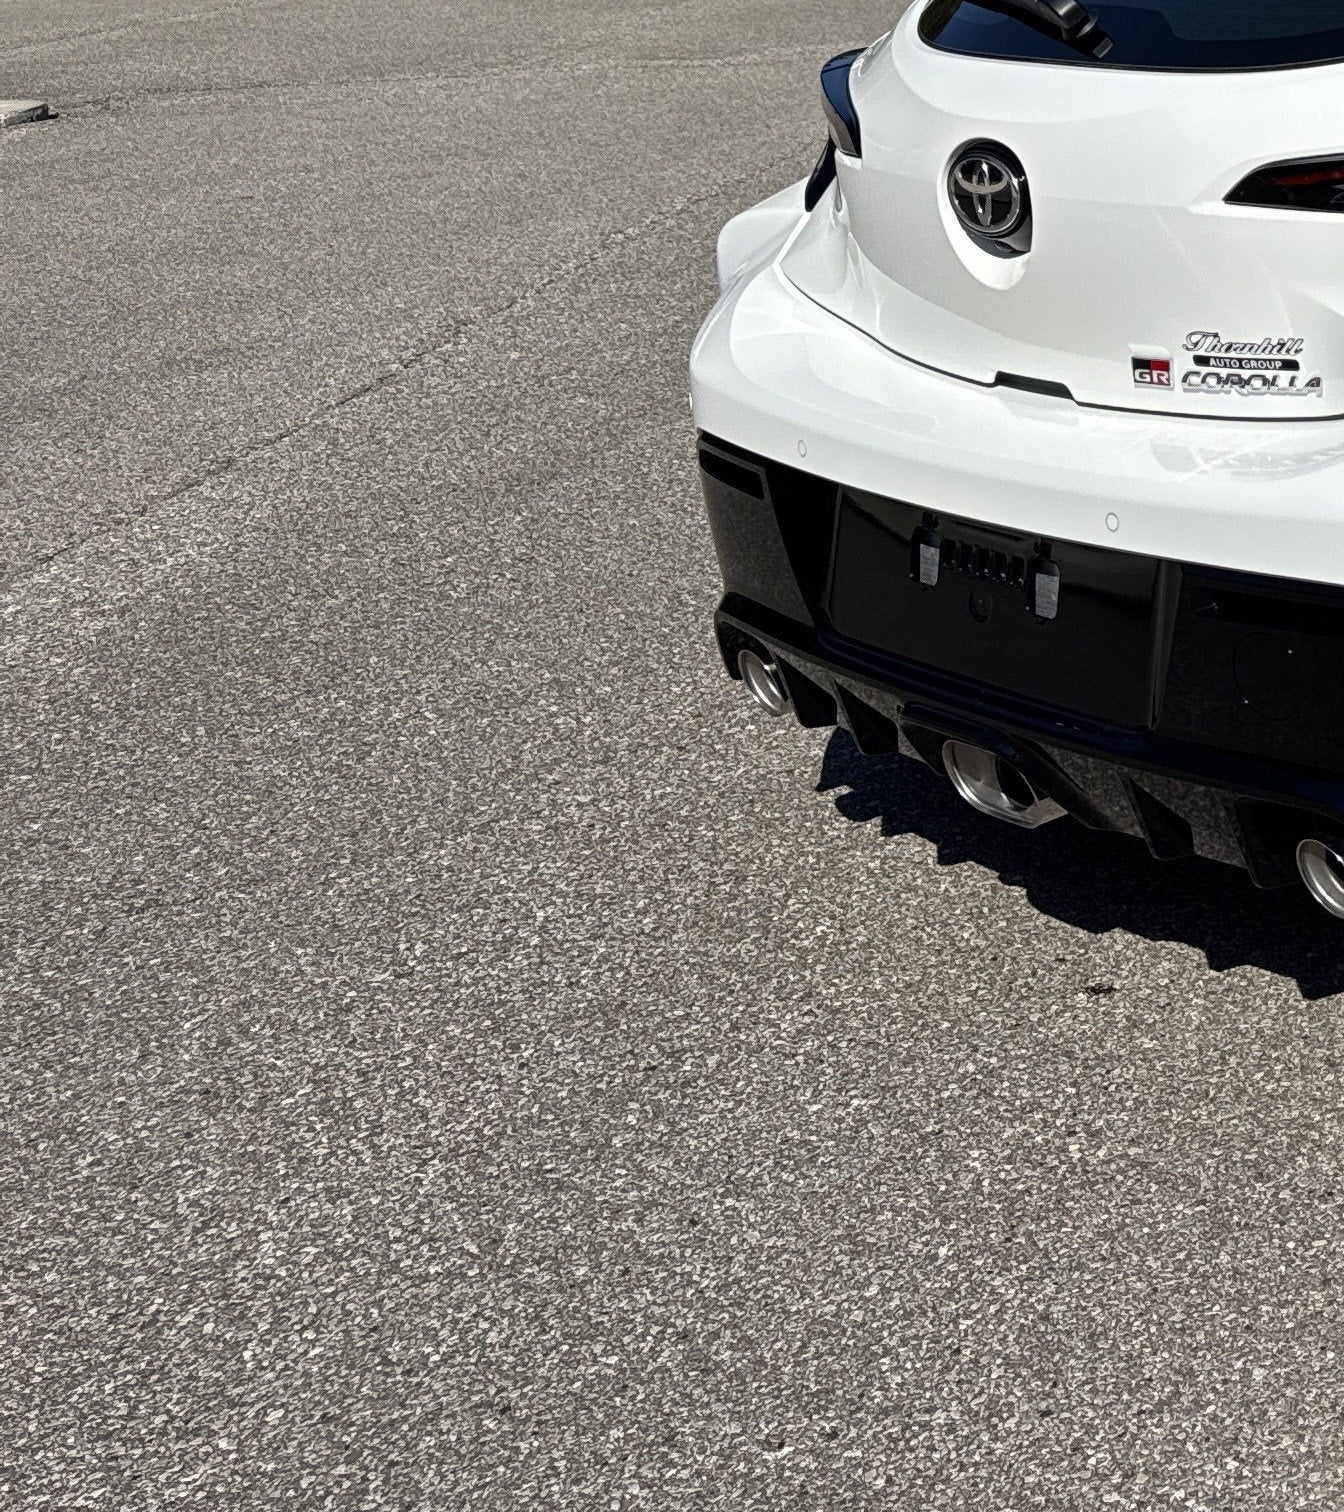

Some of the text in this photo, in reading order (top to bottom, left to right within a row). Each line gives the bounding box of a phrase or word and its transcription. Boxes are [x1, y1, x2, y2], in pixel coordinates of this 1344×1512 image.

[1182, 331, 1304, 356] Thornhill
[1209, 357, 1283, 370] AUTO GROUP
[1134, 369, 1170, 385] GR
[1181, 370, 1323, 396] COROLLA
